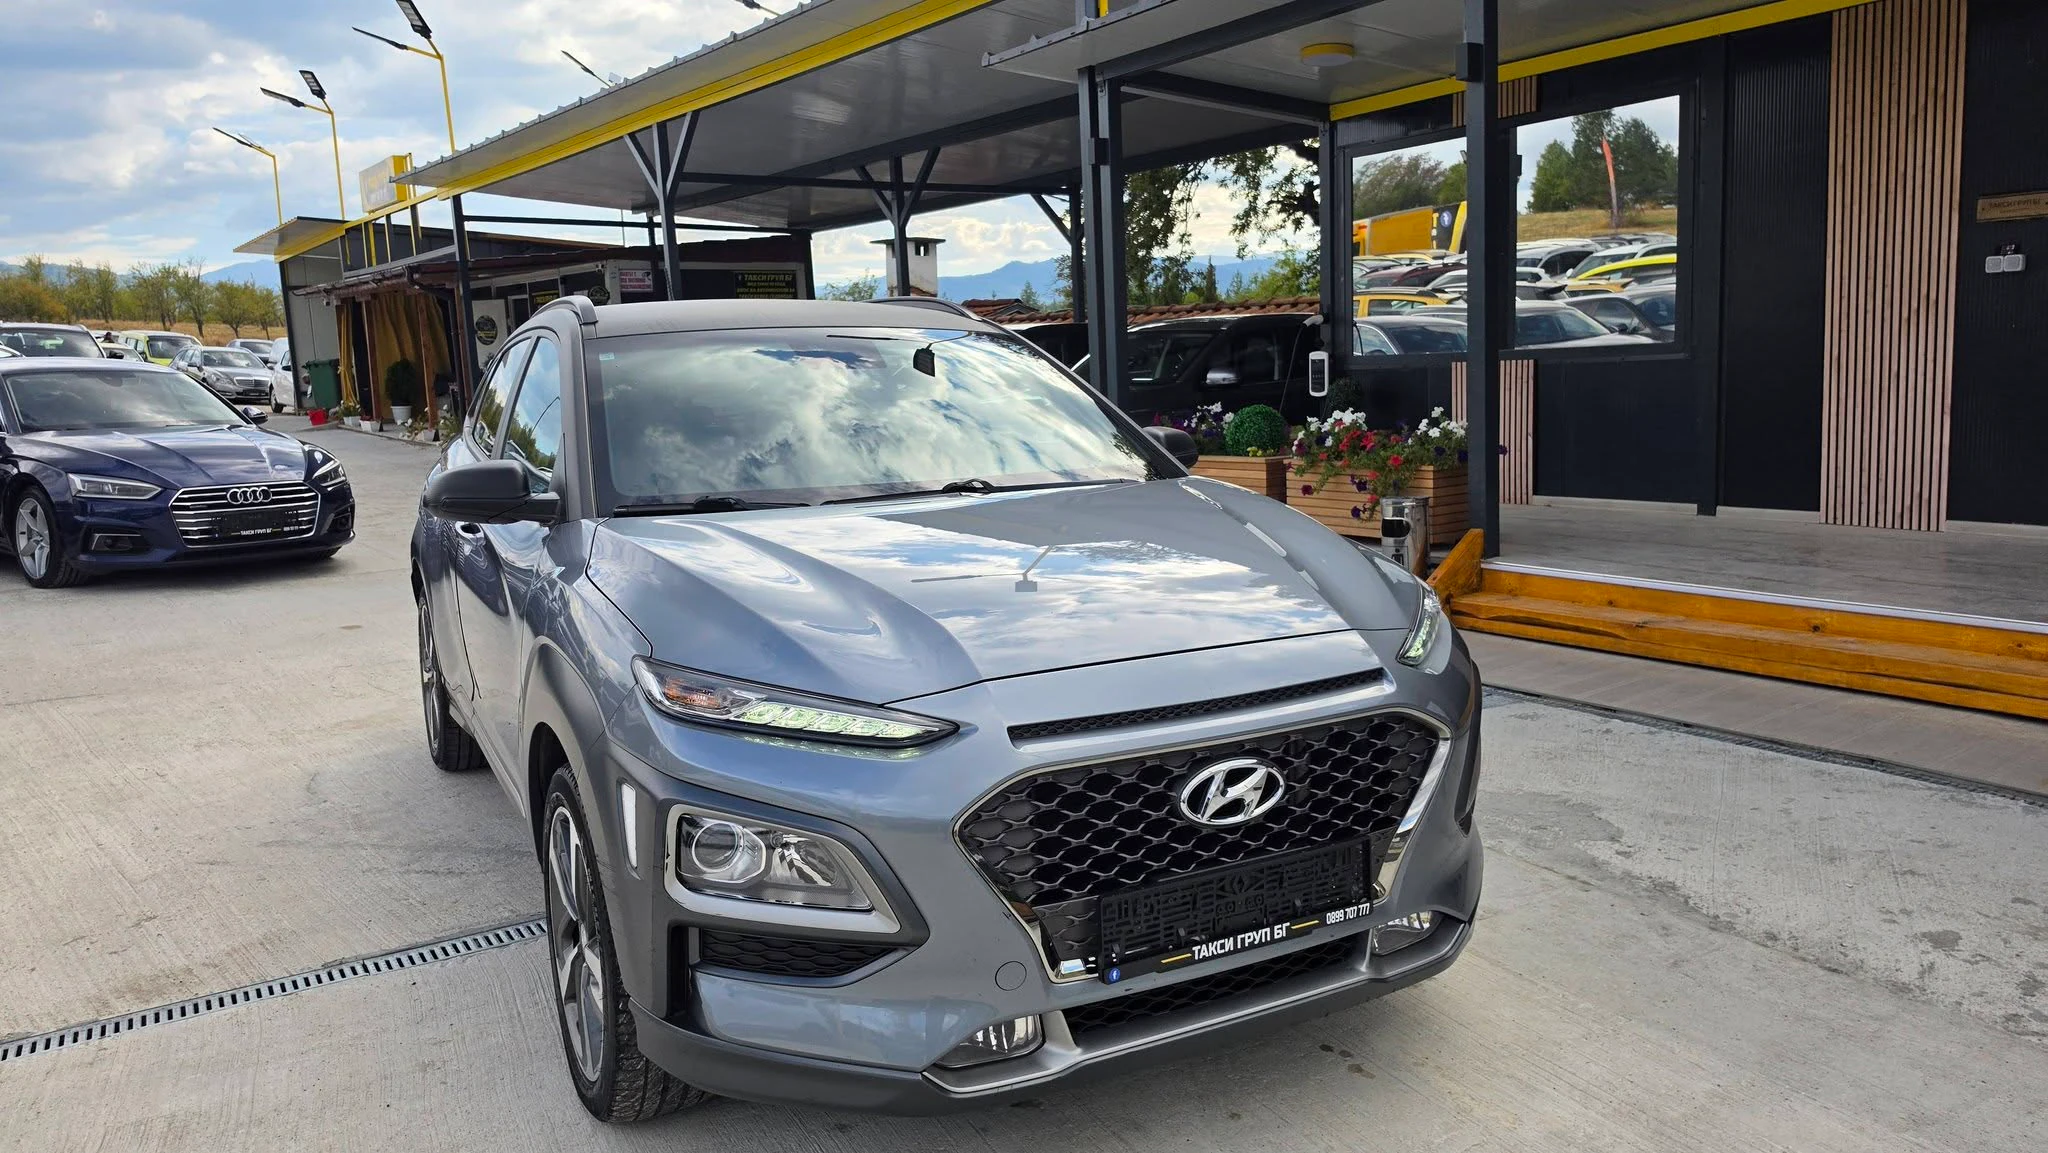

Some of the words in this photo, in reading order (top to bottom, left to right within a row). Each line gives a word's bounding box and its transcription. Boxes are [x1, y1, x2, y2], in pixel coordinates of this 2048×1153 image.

[1326, 907, 1345, 925] 0899
[1345, 905, 1358, 920] 707
[1358, 903, 1370, 917] 777
[1192, 939, 1234, 960] ТАКСИ
[1237, 931, 1271, 949] ГРУП
[1273, 922, 1290, 941] БГ
